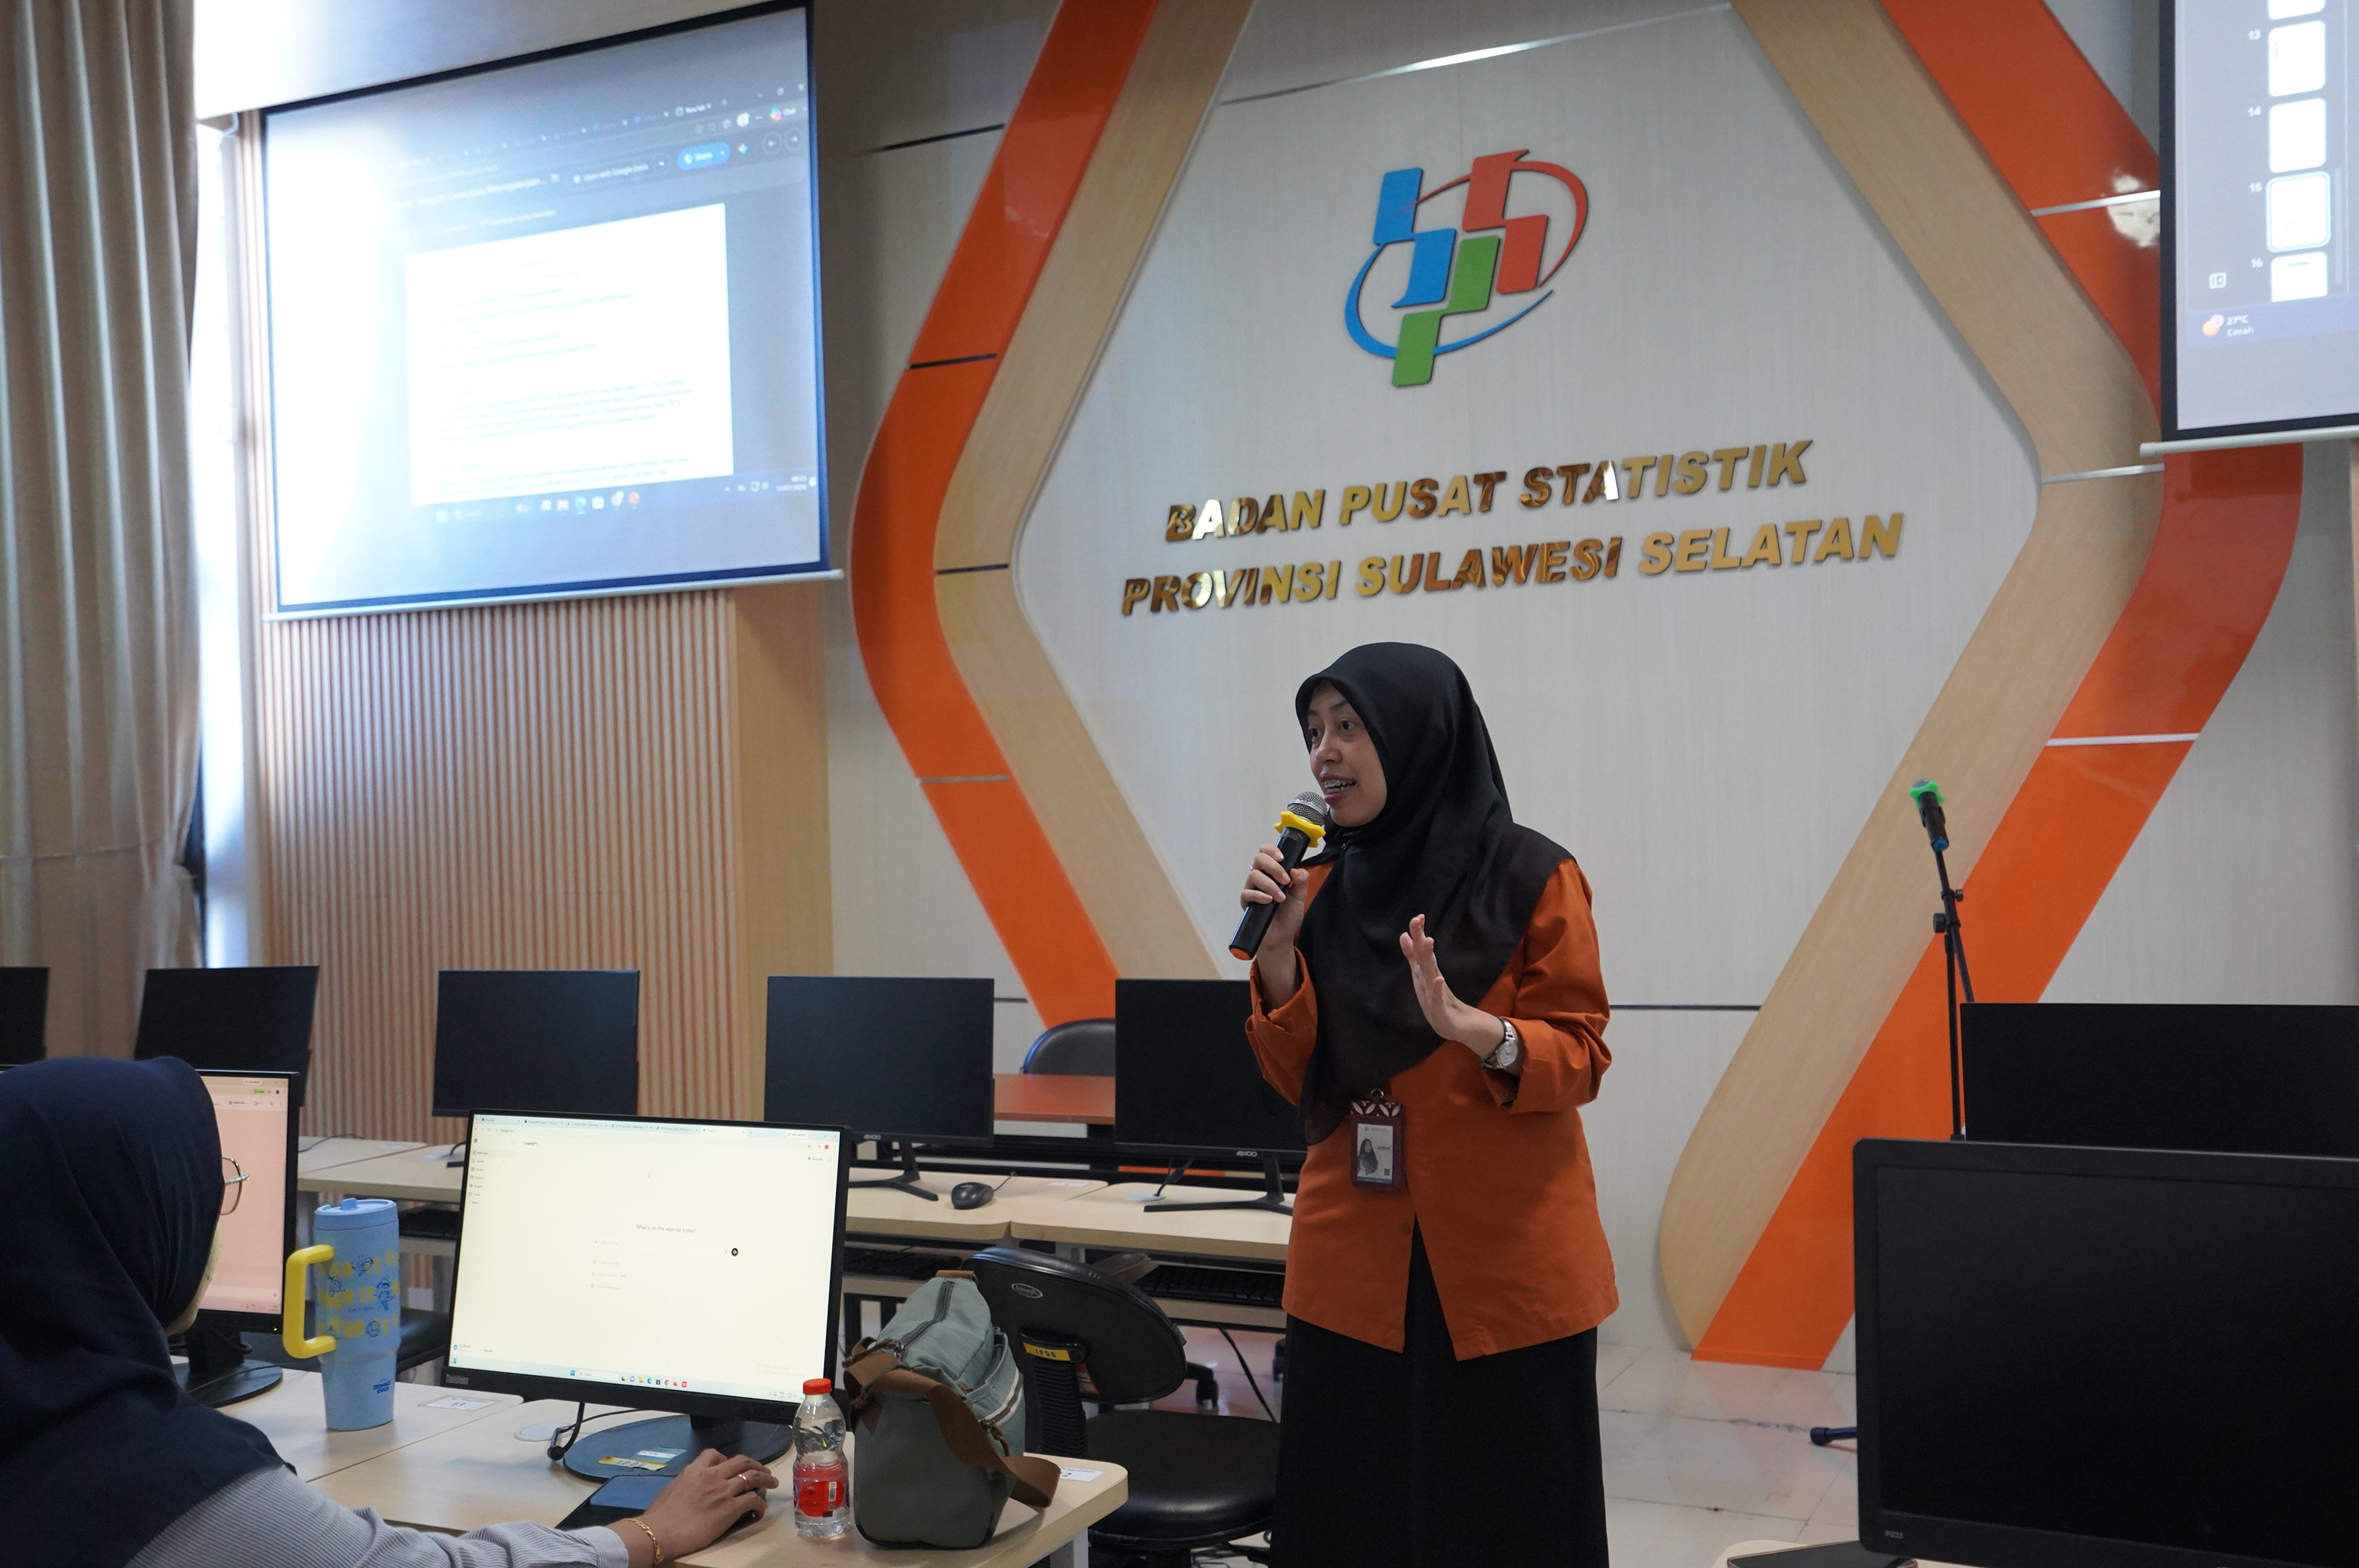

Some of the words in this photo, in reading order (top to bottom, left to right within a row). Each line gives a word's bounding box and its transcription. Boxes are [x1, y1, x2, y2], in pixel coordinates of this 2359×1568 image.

[2248, 29, 2261, 41] 13
[2248, 107, 2262, 117] 14
[2249, 183, 2263, 194] 15
[2250, 257, 2263, 268] 16
[2226, 326, 2255, 337] Cerah
[1165, 488, 1325, 542] BADAN
[1339, 470, 1507, 526] PUSAT
[1519, 440, 1814, 508] STATISTIK
[1121, 560, 1342, 616] PROVINSI
[1354, 536, 1623, 597] SULAWESI
[1638, 512, 1904, 575] SELATAN
